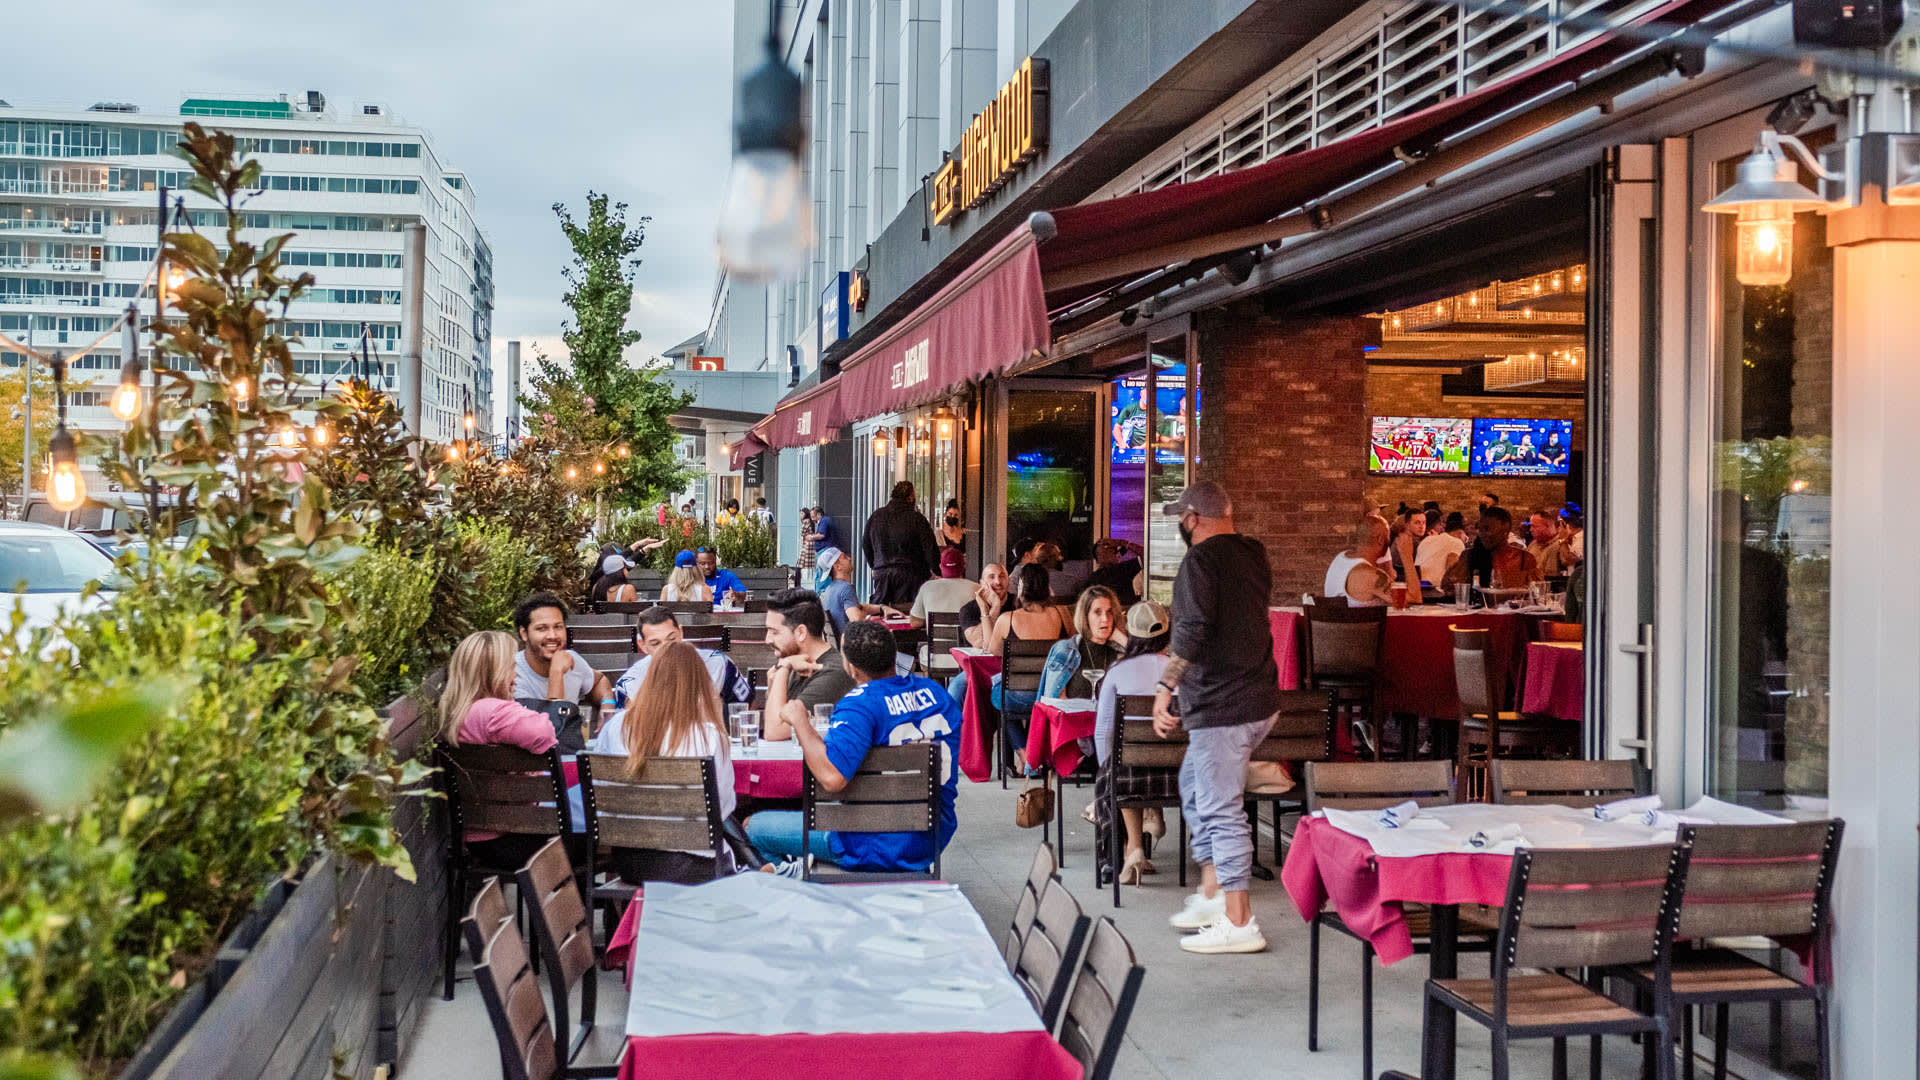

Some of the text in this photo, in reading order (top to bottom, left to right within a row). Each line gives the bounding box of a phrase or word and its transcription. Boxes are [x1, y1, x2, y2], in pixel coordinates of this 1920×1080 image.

[961, 56, 1031, 211] HIGHWOOD
[747, 455, 759, 484] VUE
[1382, 459, 1459, 472] TOUCHDOWN
